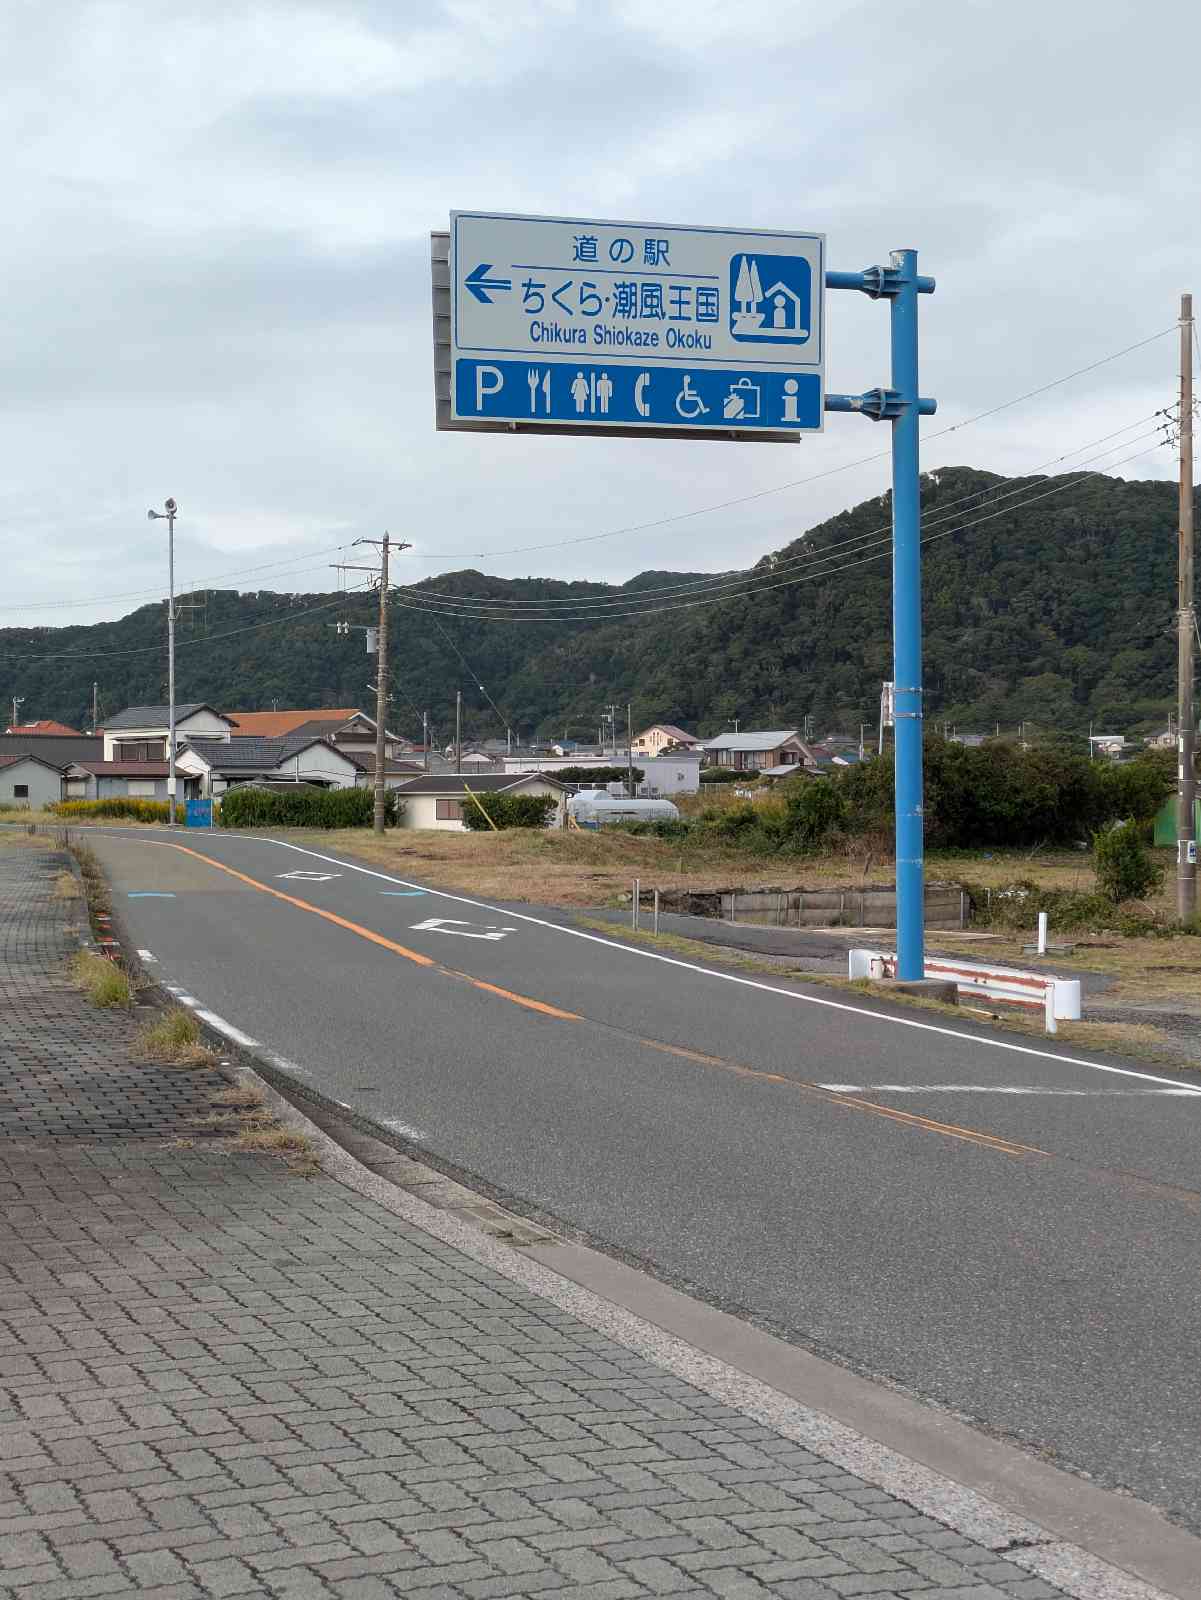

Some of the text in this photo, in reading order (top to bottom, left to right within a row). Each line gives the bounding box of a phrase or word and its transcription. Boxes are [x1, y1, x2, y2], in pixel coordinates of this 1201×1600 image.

[572, 235, 671, 267] 道の駅
[529, 320, 712, 350] Chikura Shiokaze Okoku
